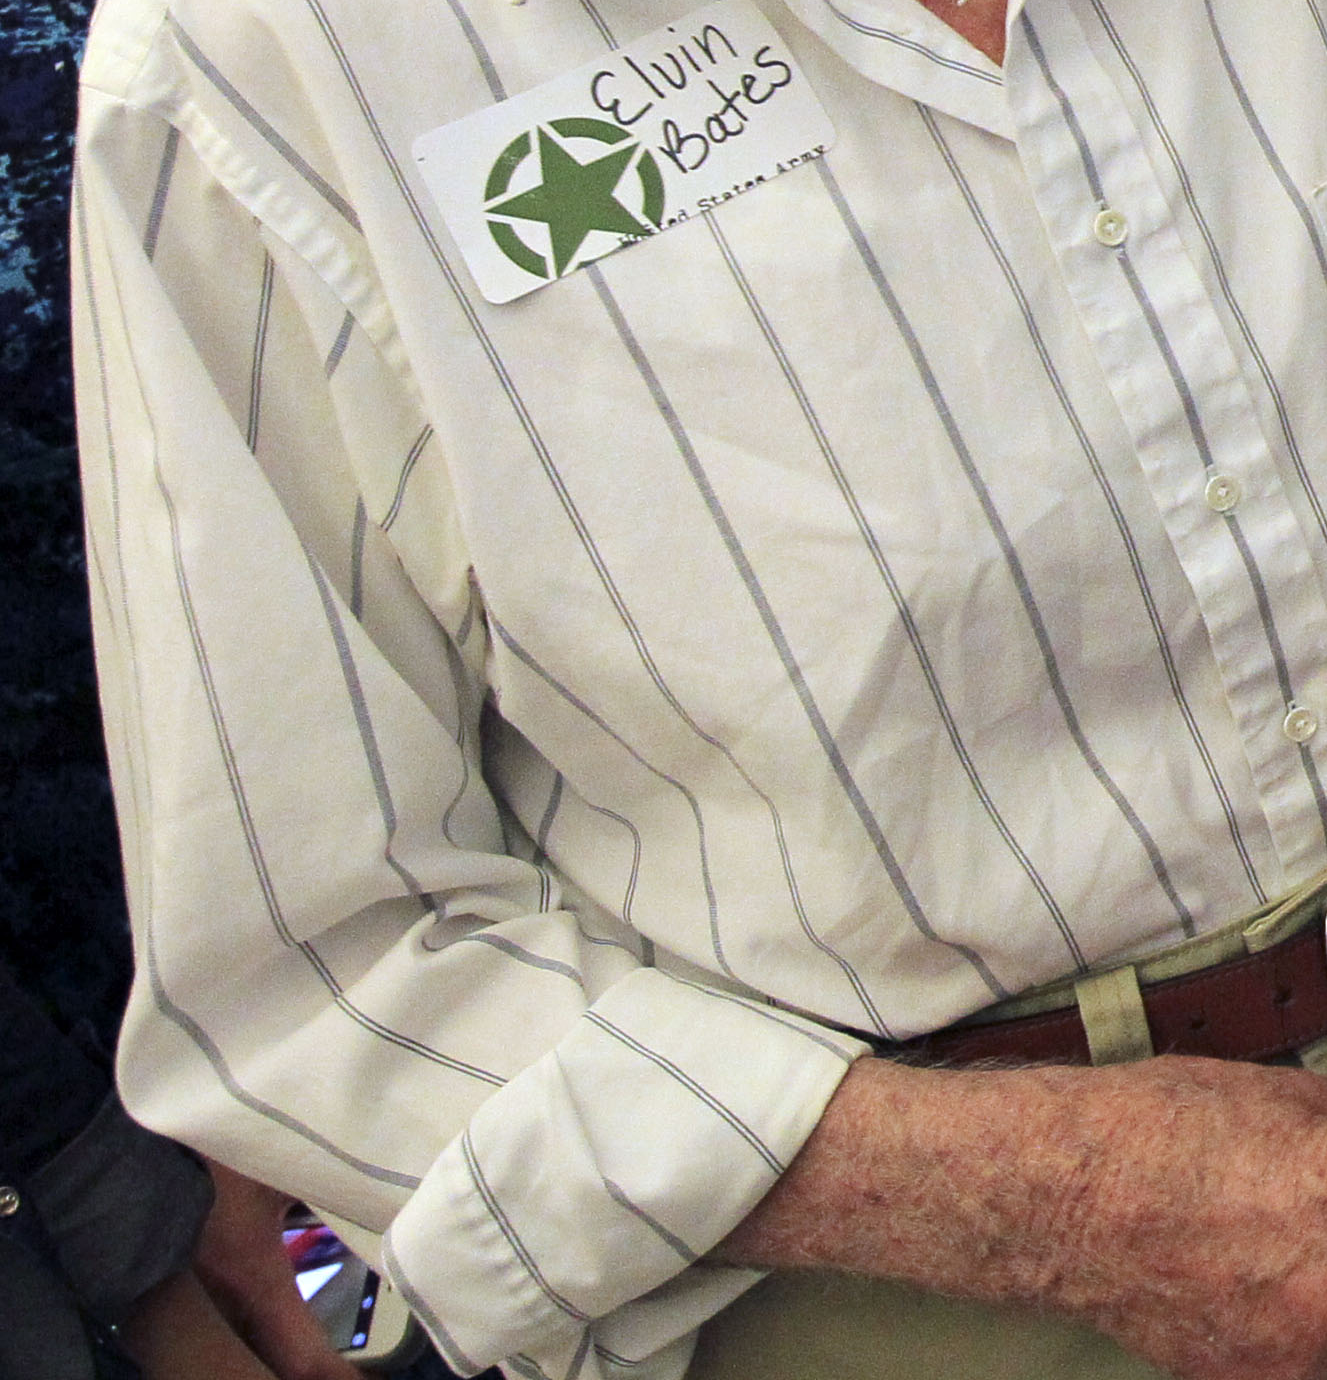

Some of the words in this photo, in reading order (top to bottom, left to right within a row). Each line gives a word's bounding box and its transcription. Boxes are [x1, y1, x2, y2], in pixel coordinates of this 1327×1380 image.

[590, 24, 738, 126] Elvin
[658, 46, 793, 173] Bates
[777, 144, 828, 175] Army
